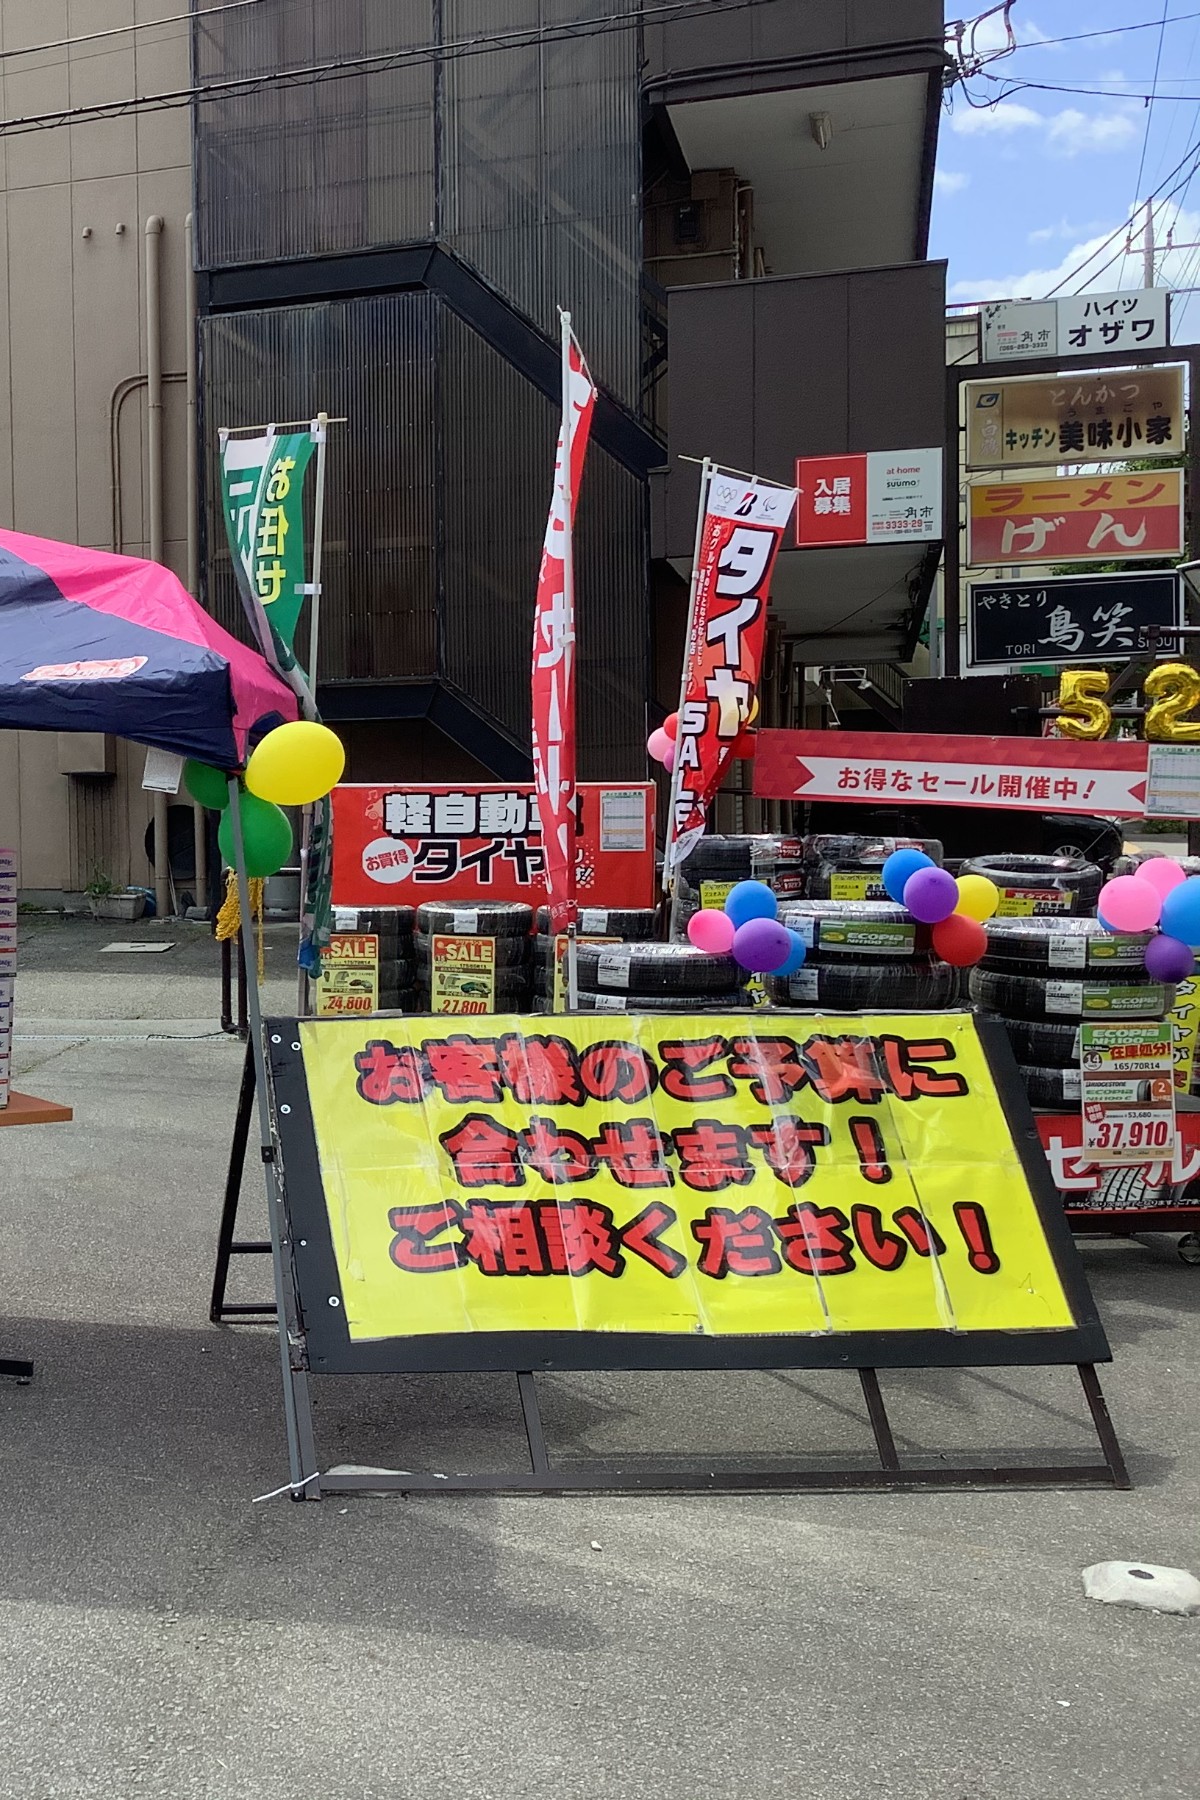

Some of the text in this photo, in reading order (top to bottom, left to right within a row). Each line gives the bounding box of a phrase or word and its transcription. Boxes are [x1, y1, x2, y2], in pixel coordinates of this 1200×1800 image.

[1084, 298, 1138, 317] ハイツ
[1068, 319, 1155, 347] オザワ
[1050, 384, 1141, 406] とんかつ
[1006, 427, 1056, 450] キッチン
[1059, 416, 1172, 453] 美味小家
[814, 478, 851, 496] 入居
[985, 480, 1166, 513] ラーメン
[1000, 512, 1147, 555] げん
[978, 590, 1047, 610] やきとり
[706, 525, 776, 737] タイヤ
[1005, 644, 1035, 655] TORI
[837, 766, 1097, 801] お得なセール開催中!
[366, 849, 409, 870] お買得
[413, 838, 545, 884] タイヤ
[847, 932, 905, 940] ECOPIA
[330, 941, 377, 958] SALE
[445, 943, 493, 961] SALE
[1092, 1029, 1160, 1037] ECOPIA
[1086, 1054, 1100, 1063] 14
[1110, 1042, 1171, 1060] 在庫処分!
[355, 1036, 969, 1105] お客様のご予算に
[1114, 1062, 1160, 1071] 165/70R14
[1158, 1082, 1166, 1093] 2
[439, 1113, 893, 1190] 合わせます!
[388, 1200, 1001, 1278] ご相談ください!
